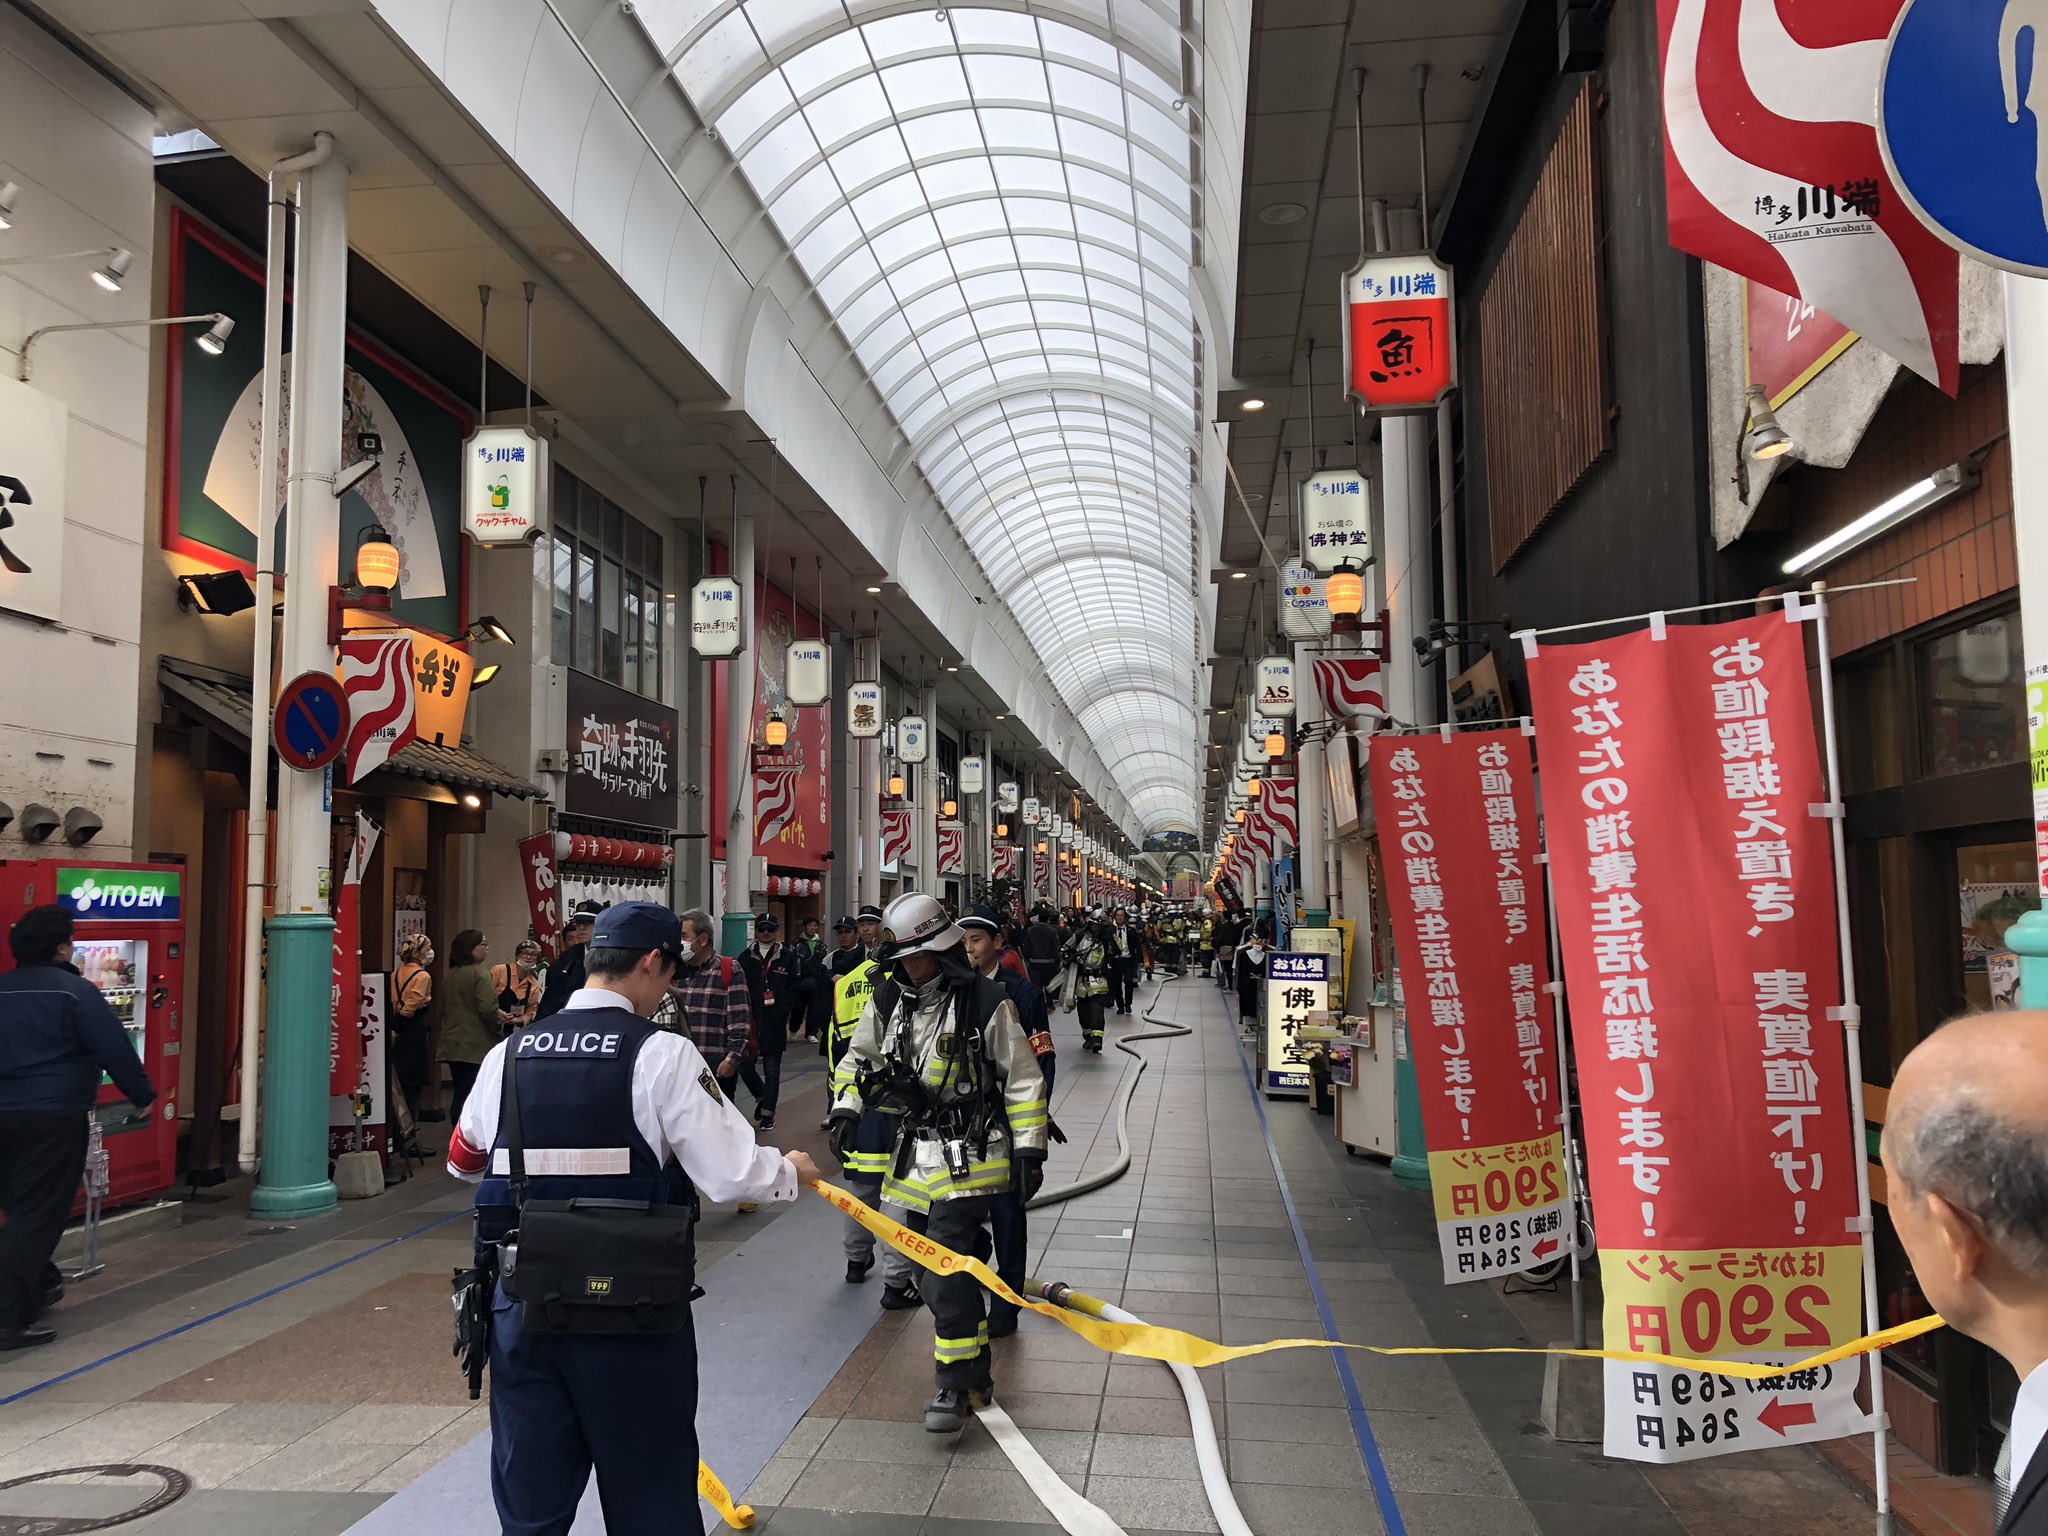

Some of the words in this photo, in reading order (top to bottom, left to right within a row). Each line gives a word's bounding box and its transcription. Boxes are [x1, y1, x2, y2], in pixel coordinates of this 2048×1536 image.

[1754, 178, 1881, 225] 博多川端
[1767, 228, 1811, 242] Hakata
[1815, 222, 1873, 237] Kawabata
[1362, 272, 1437, 297] 博多川端
[1369, 328, 1423, 383] 魚
[478, 447, 525, 463] 博多川端
[1312, 481, 1360, 497] 博多川端
[1308, 530, 1368, 547] 佛神堂
[1263, 685, 1290, 698] AS
[581, 713, 668, 793] 奇跡の手羽先
[601, 771, 652, 799] サラリーマン横丁
[100, 885, 137, 907] ITO
[138, 886, 165, 907] EN
[1273, 957, 1324, 972] お仏壇
[517, 1032, 621, 1054] POLICE
[894, 1229, 936, 1257] KEEP
